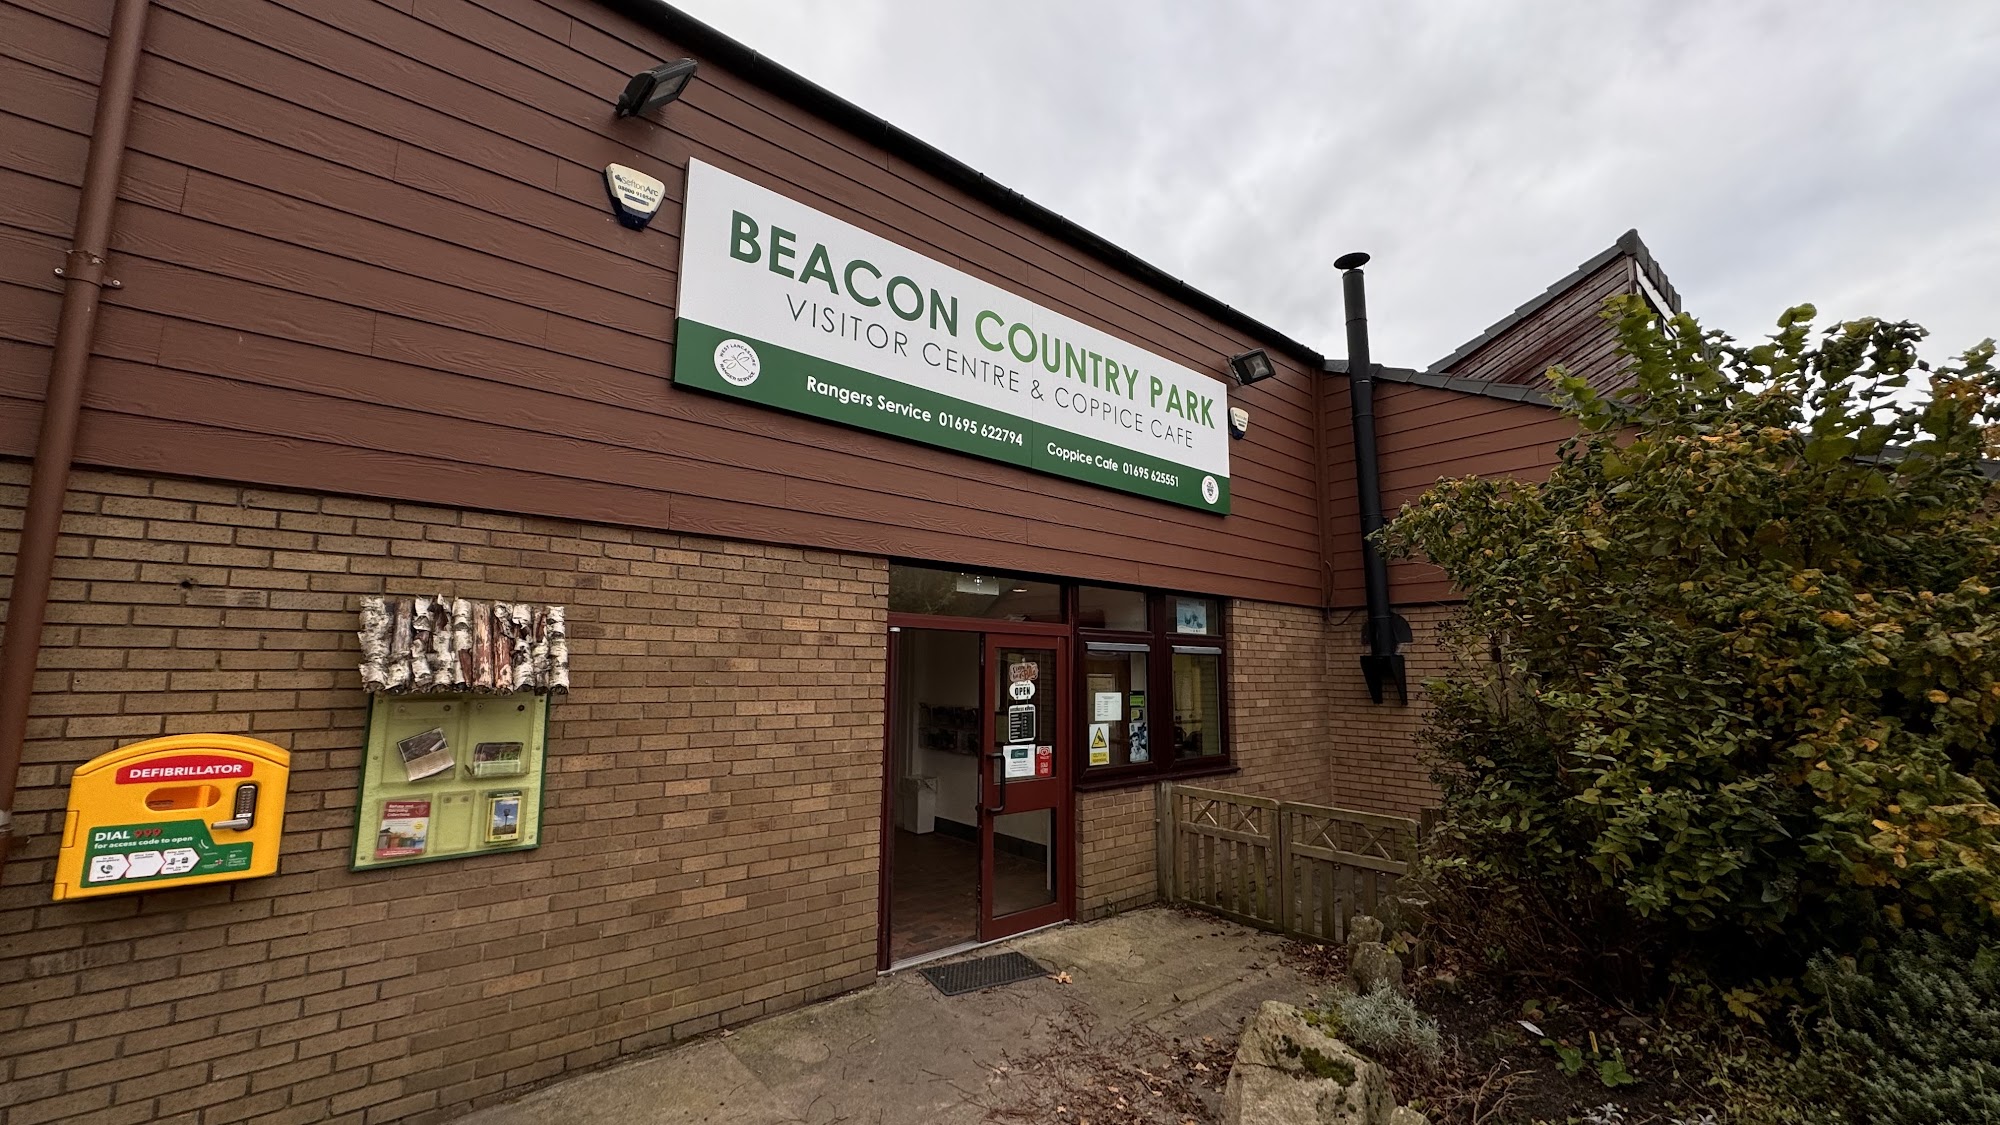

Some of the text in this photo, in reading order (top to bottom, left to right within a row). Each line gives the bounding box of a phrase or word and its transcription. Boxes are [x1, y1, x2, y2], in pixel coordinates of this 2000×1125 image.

[730, 209, 1215, 429] BEACON COUNTRY PARK
[786, 293, 1193, 449] VISITOR CENTRE & COPPICE CAFE
[807, 376, 1023, 446] Rangers Service 01695 622794
[1047, 442, 1180, 487] Coppice Cafe 01695 625551
[1014, 687, 1031, 696] OPEN
[129, 764, 242, 779] DEFIBRILLATOR
[94, 830, 131, 842] DIAL
[138, 838, 160, 846] code
[171, 836, 193, 844] open
